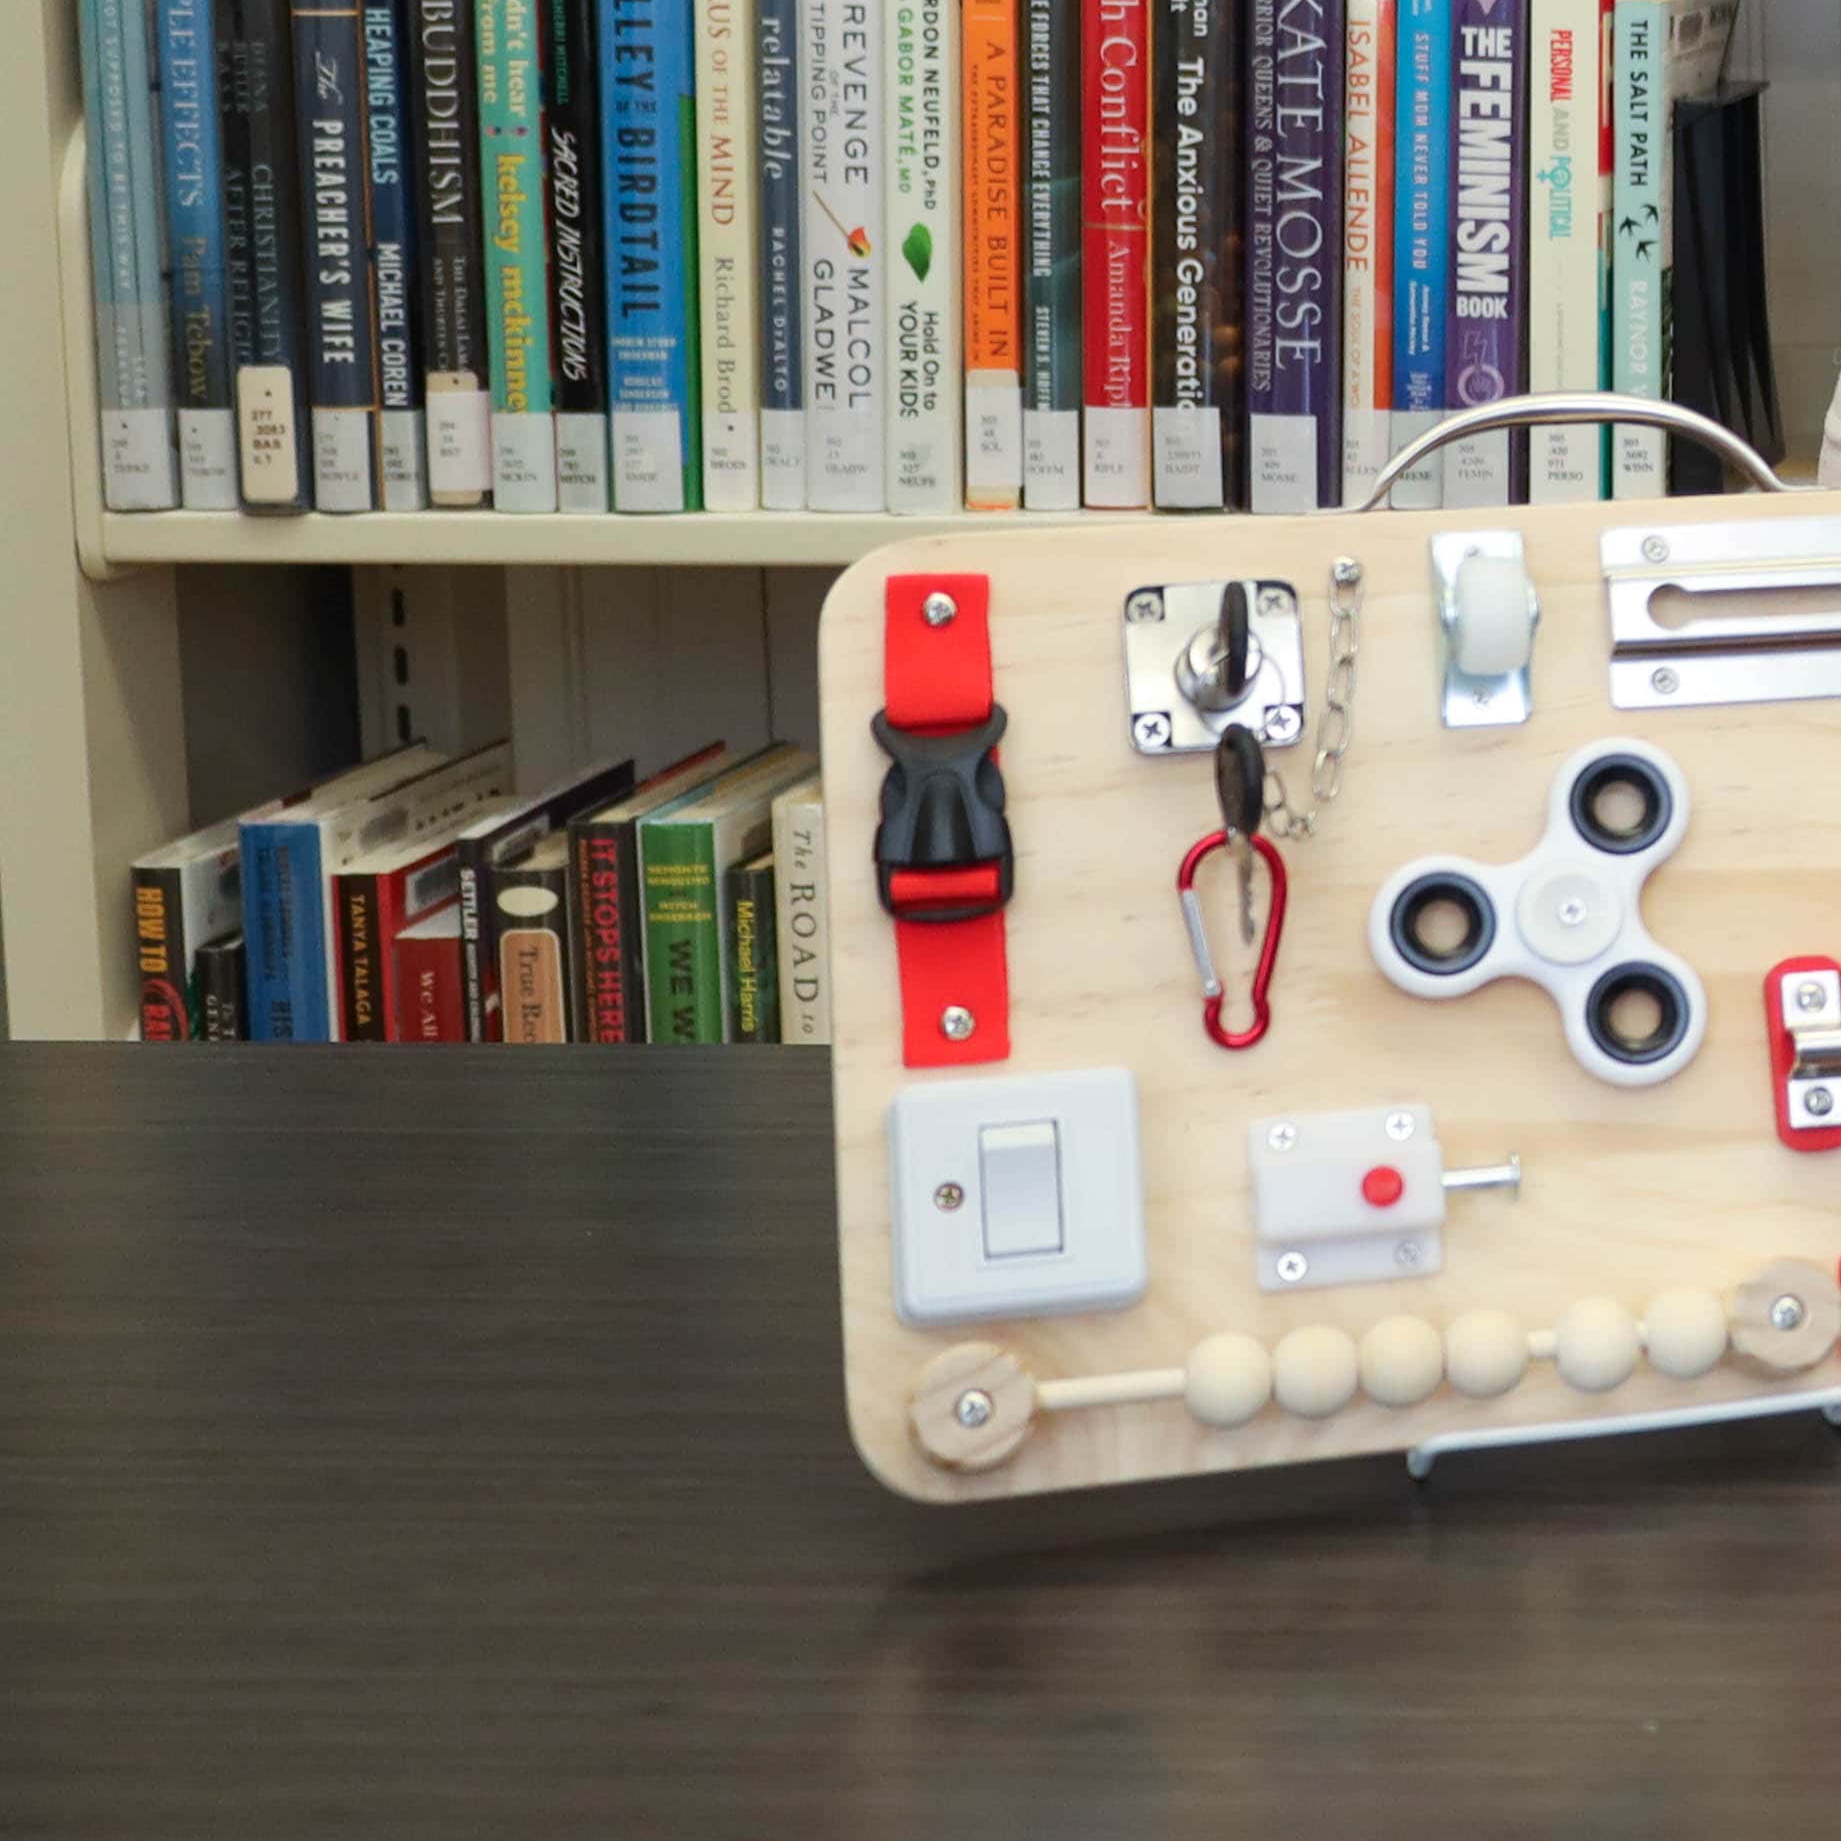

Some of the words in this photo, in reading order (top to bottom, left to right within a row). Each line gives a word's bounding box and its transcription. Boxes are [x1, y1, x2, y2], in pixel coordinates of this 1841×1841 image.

[1460, 27, 1512, 58] THE
[1630, 21, 1649, 62] THE
[1176, 58, 1205, 114] The
[1348, 21, 1375, 122] ISABEL
[1631, 72, 1649, 122] SALT
[1099, 41, 1137, 210] Conflict
[1457, 65, 1512, 291] FEMINISM
[1630, 131, 1649, 187] PATH
[1176, 128, 1203, 251] Anxious
[1349, 133, 1369, 270] ALLENDE
[617, 127, 660, 318] BIRDTAIL
[1275, 155, 1323, 368] MOSSE
[1456, 296, 1507, 319] BOOK
[793, 829, 813, 871] The
[139, 888, 163, 936] HOW
[736, 899, 756, 973] Michael
[139, 940, 167, 972] TO
[789, 882, 819, 1003] ROAD
[739, 977, 758, 1033] Harris
[800, 1015, 814, 1035] to
